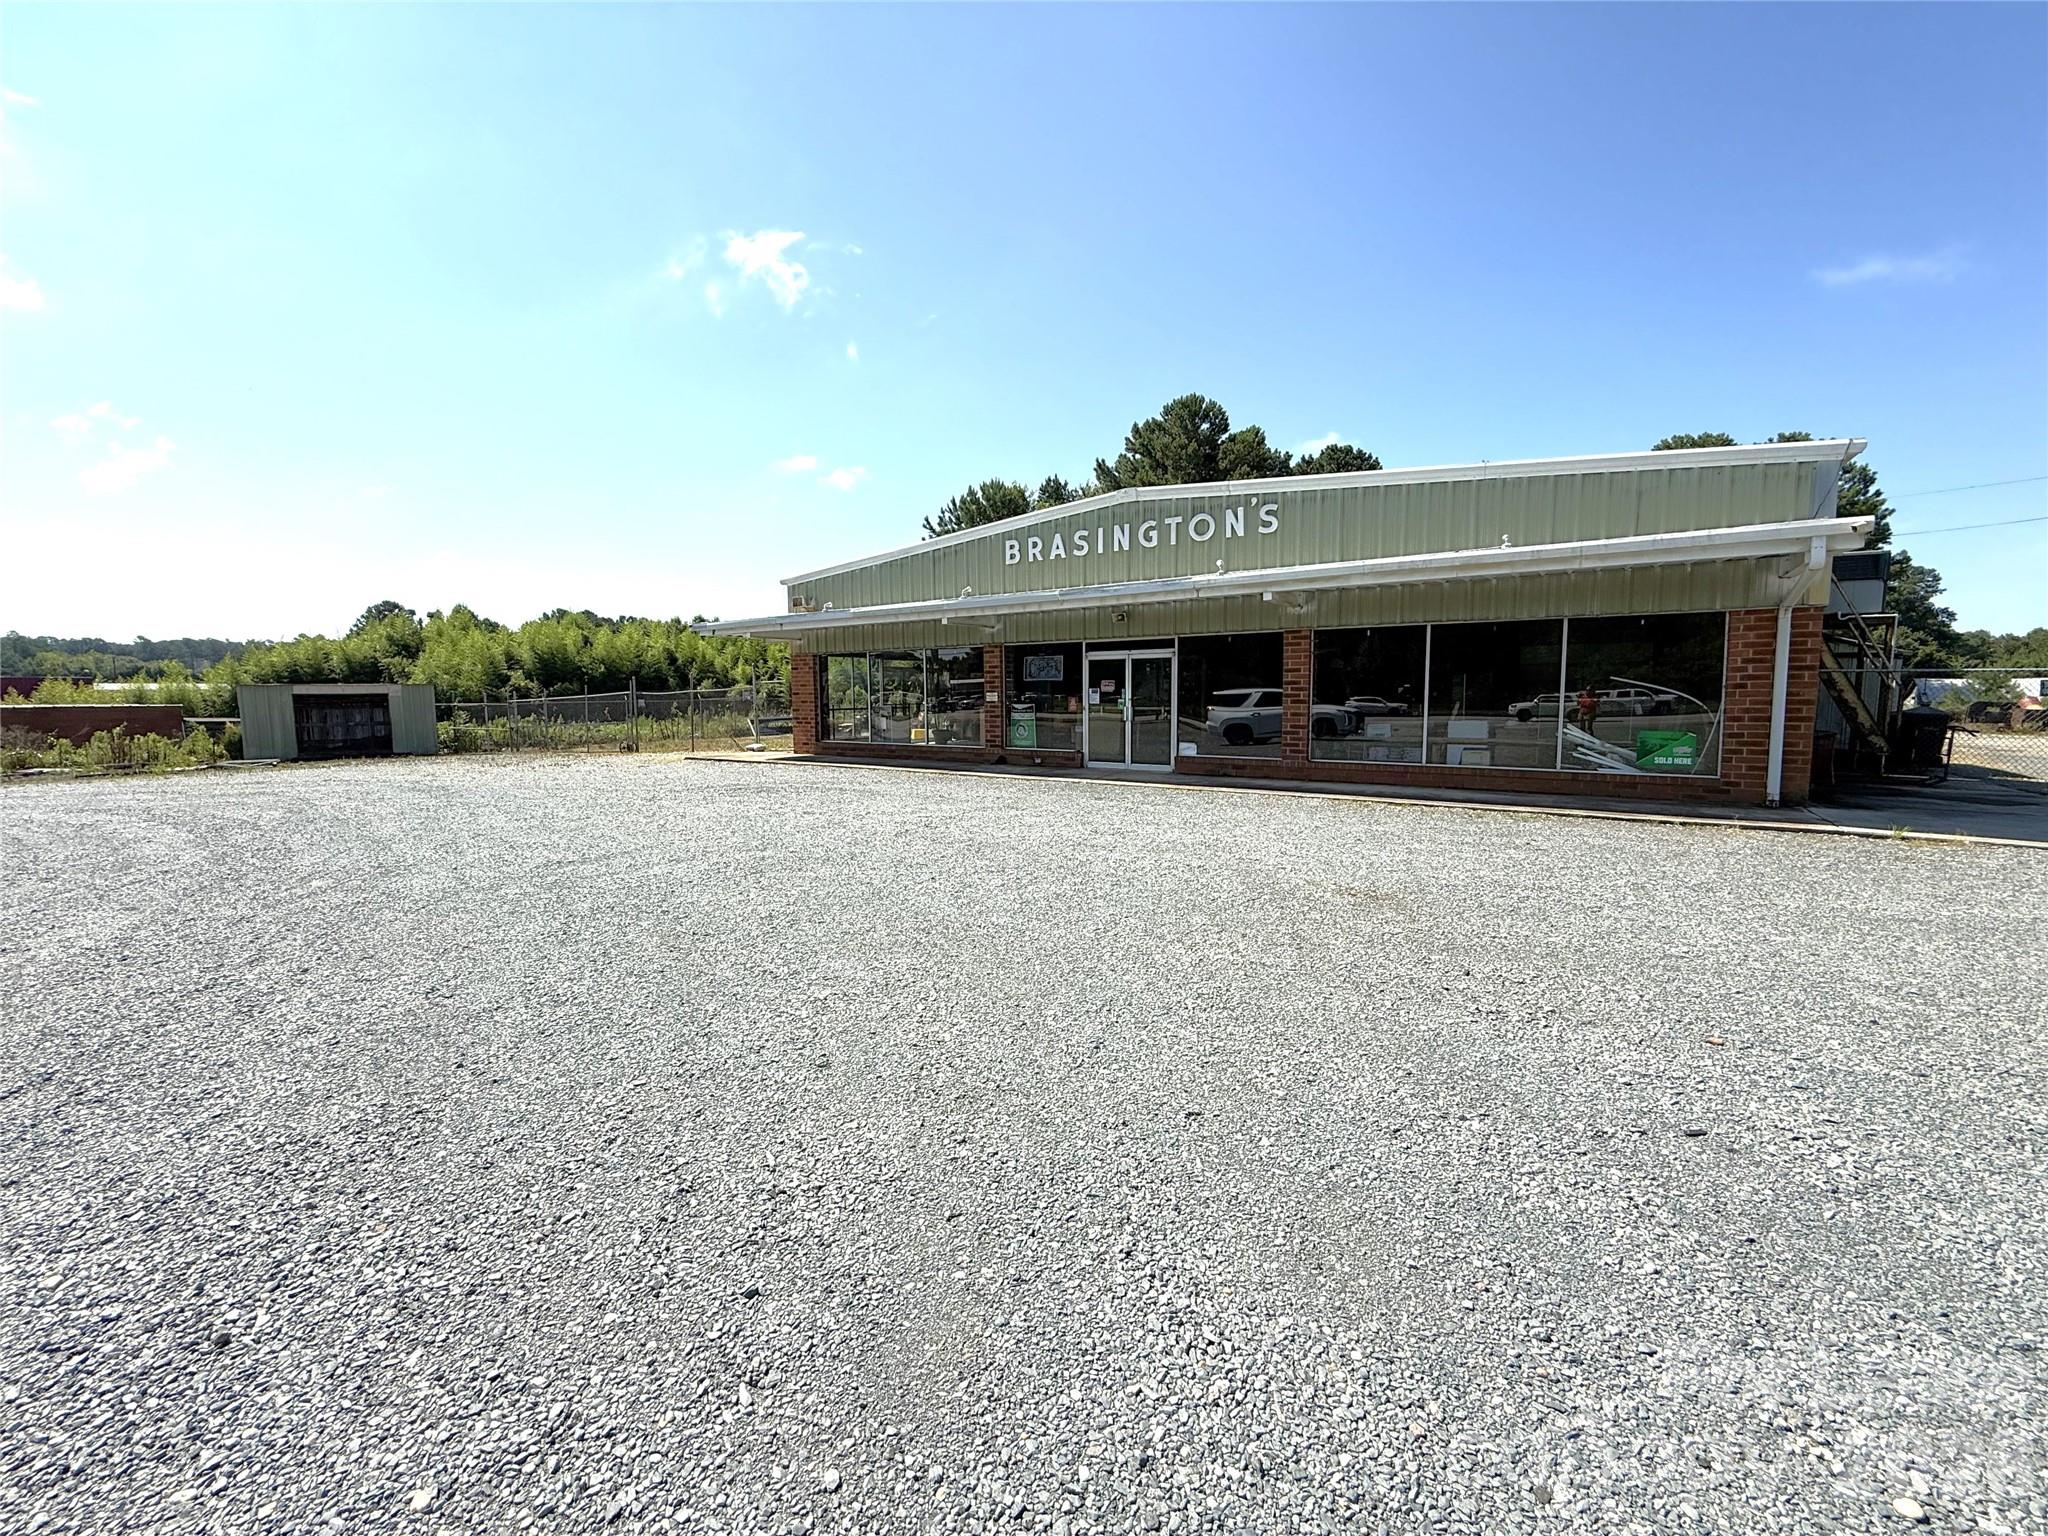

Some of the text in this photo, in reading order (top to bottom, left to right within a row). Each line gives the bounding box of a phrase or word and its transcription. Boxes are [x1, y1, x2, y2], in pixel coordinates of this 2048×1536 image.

[1005, 497, 1279, 565] BRASINGTON'S
[1654, 756, 1692, 765] SOLD HERE
